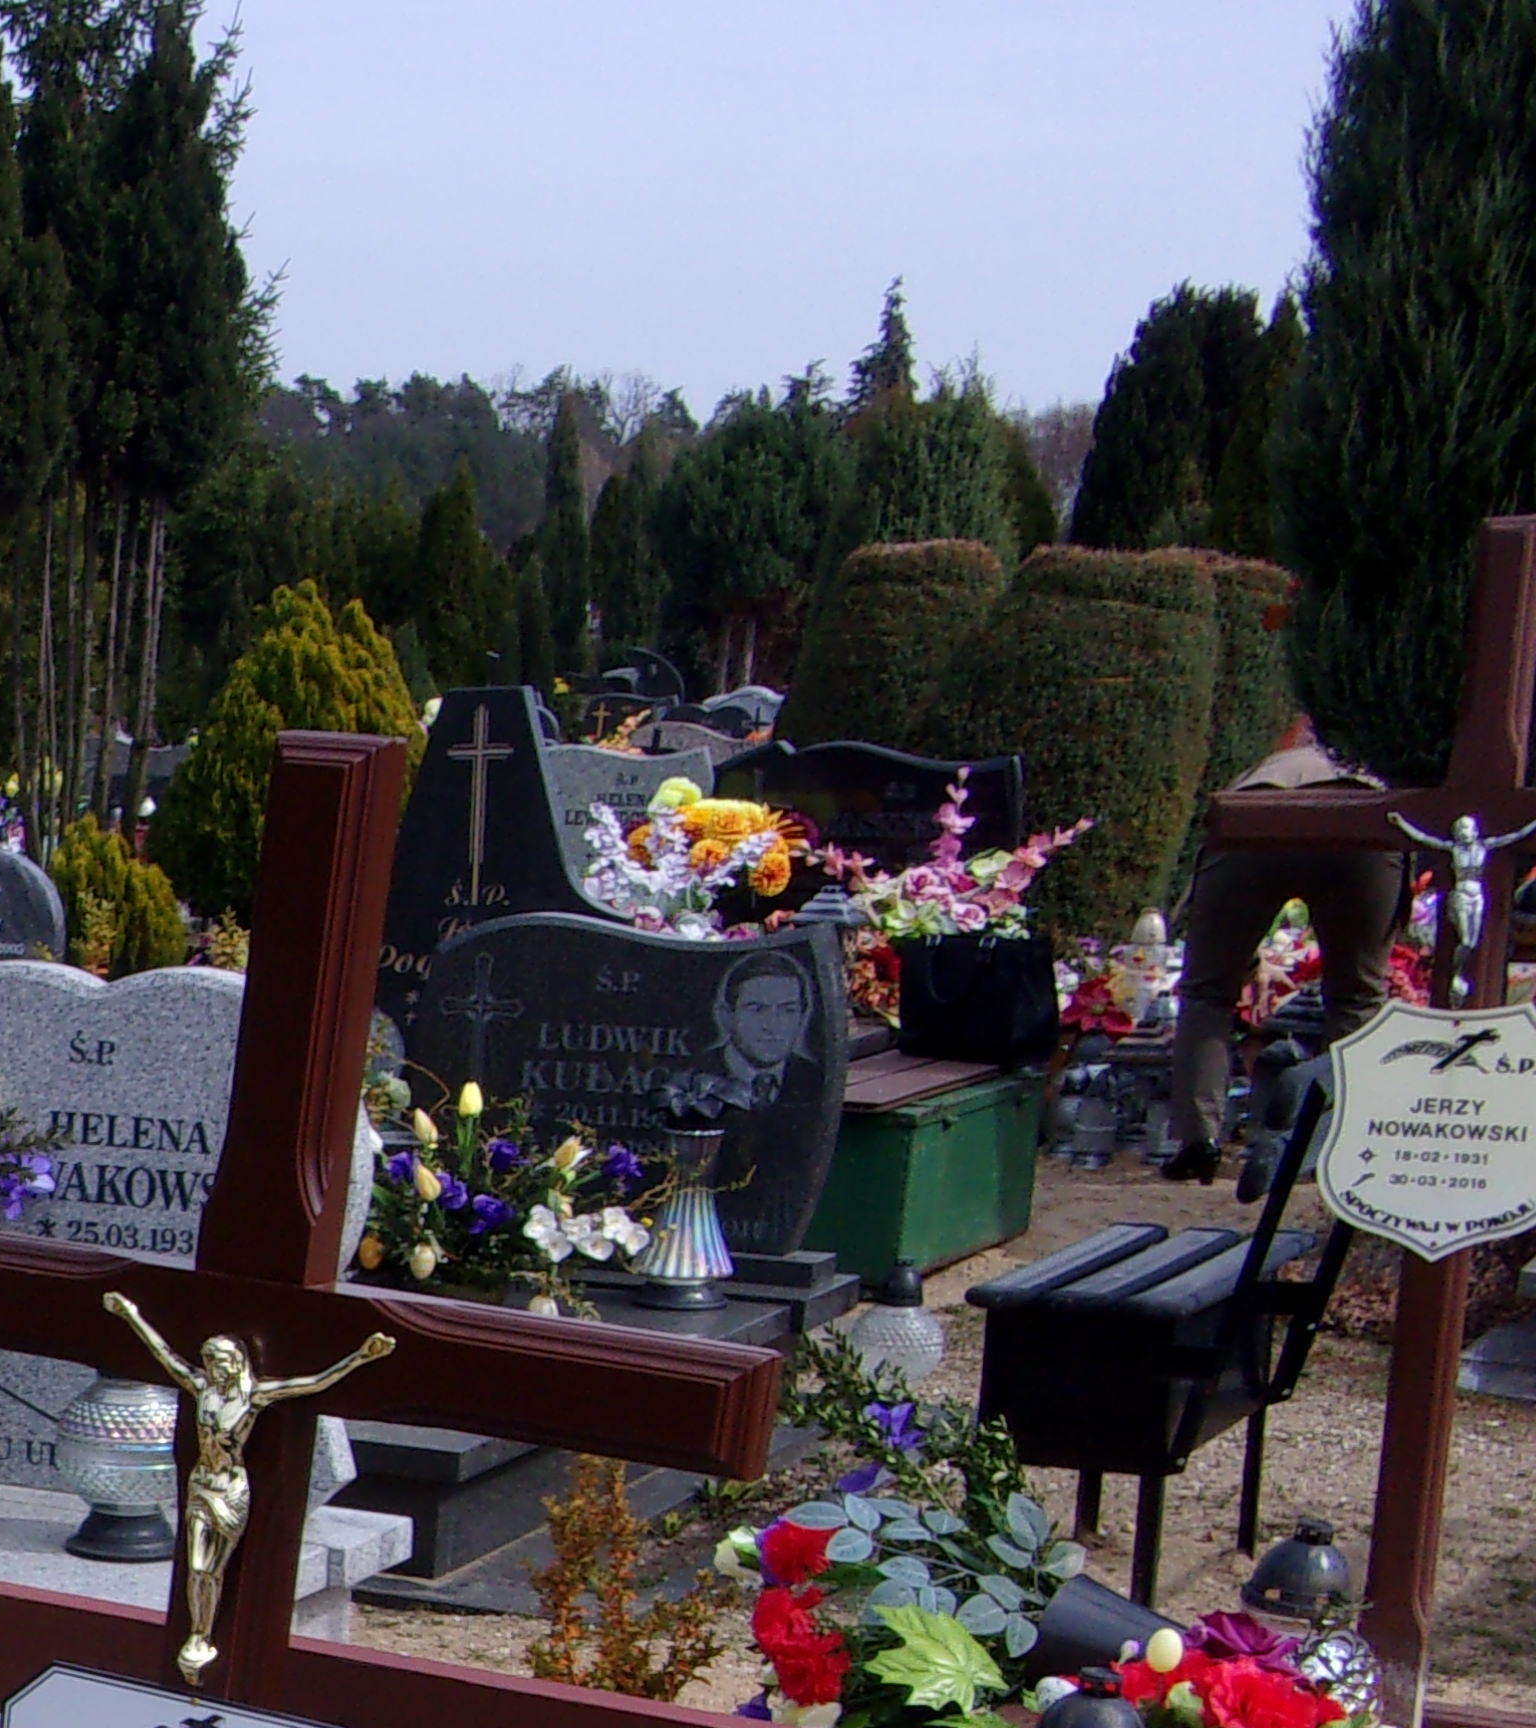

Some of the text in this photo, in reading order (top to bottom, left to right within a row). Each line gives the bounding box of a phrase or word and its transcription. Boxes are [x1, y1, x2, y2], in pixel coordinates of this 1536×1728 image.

[596, 792, 650, 808] HELEN
[538, 1020, 693, 1057] LUDWIK
[1409, 1097, 1486, 1116] JERZY
[47, 1109, 213, 1155] HELENA
[1366, 1119, 1529, 1142] NOWAKOWSKI
